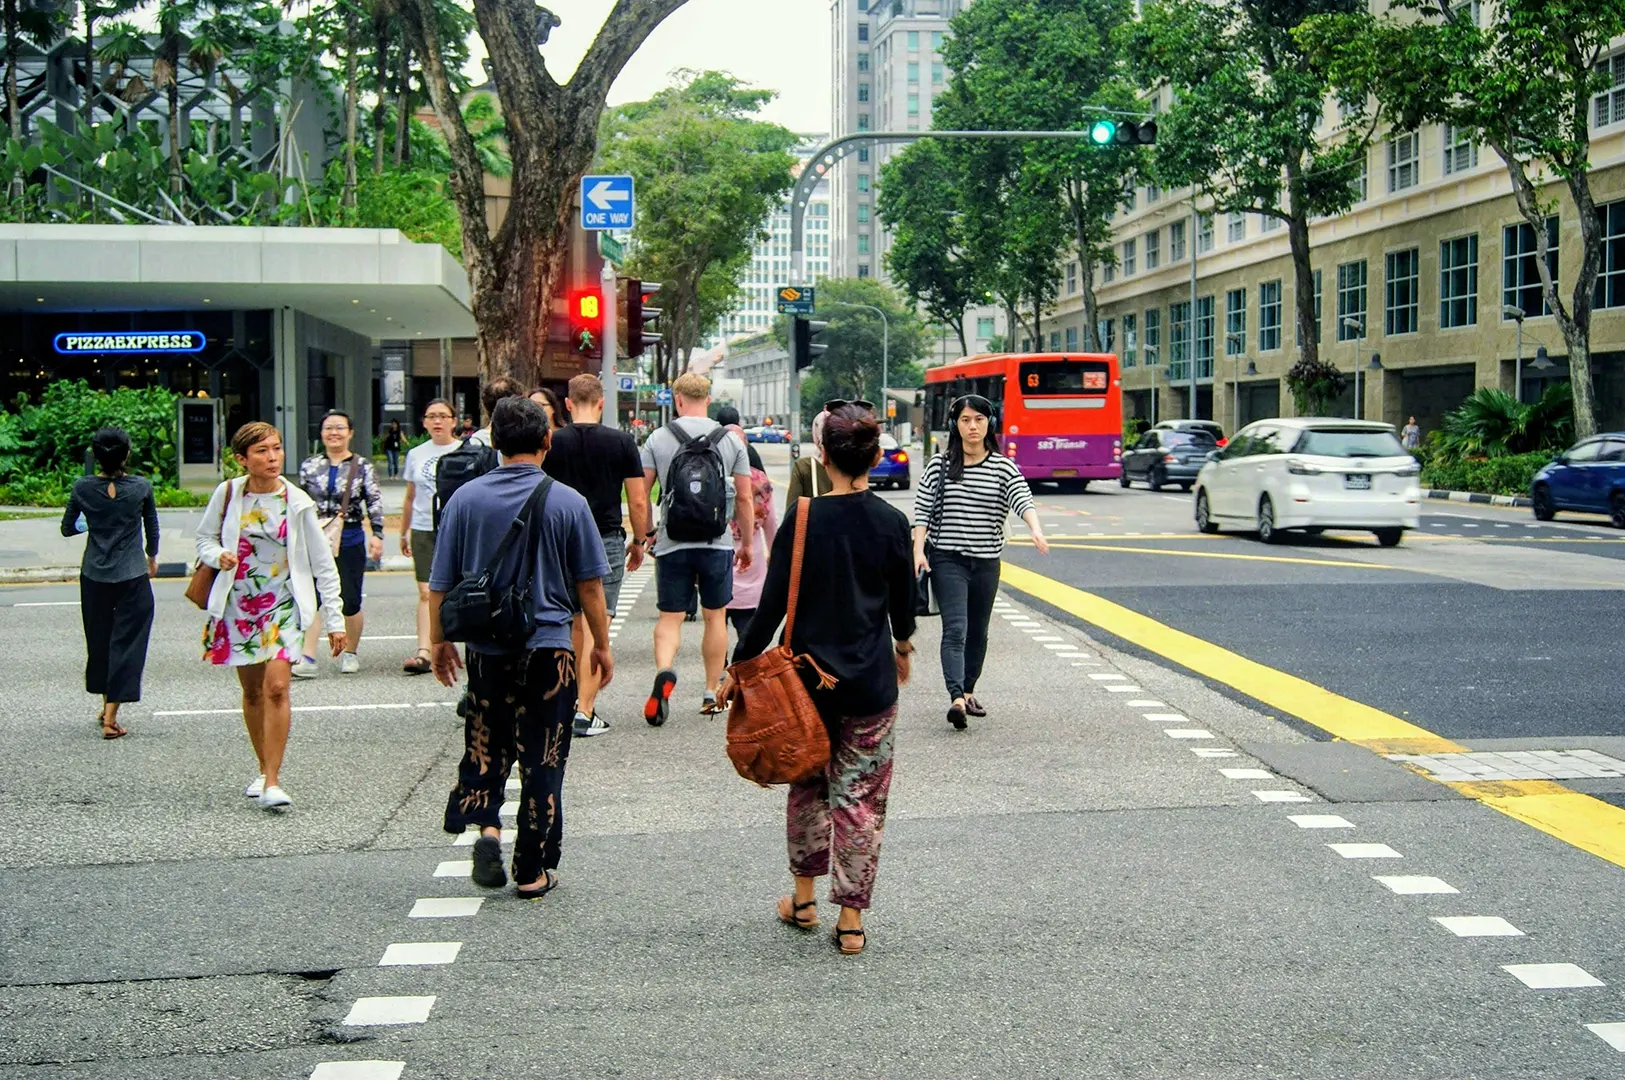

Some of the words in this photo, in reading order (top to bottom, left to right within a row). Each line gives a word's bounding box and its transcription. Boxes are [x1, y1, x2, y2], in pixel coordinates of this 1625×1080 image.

[585, 212, 606, 224] ONE
[609, 212, 629, 224] WAY
[66, 335, 193, 349] PIZZAEXPRESS
[622, 378, 632, 389] P
[1037, 441, 1054, 450] SBS
[1055, 438, 1088, 450] Transit
